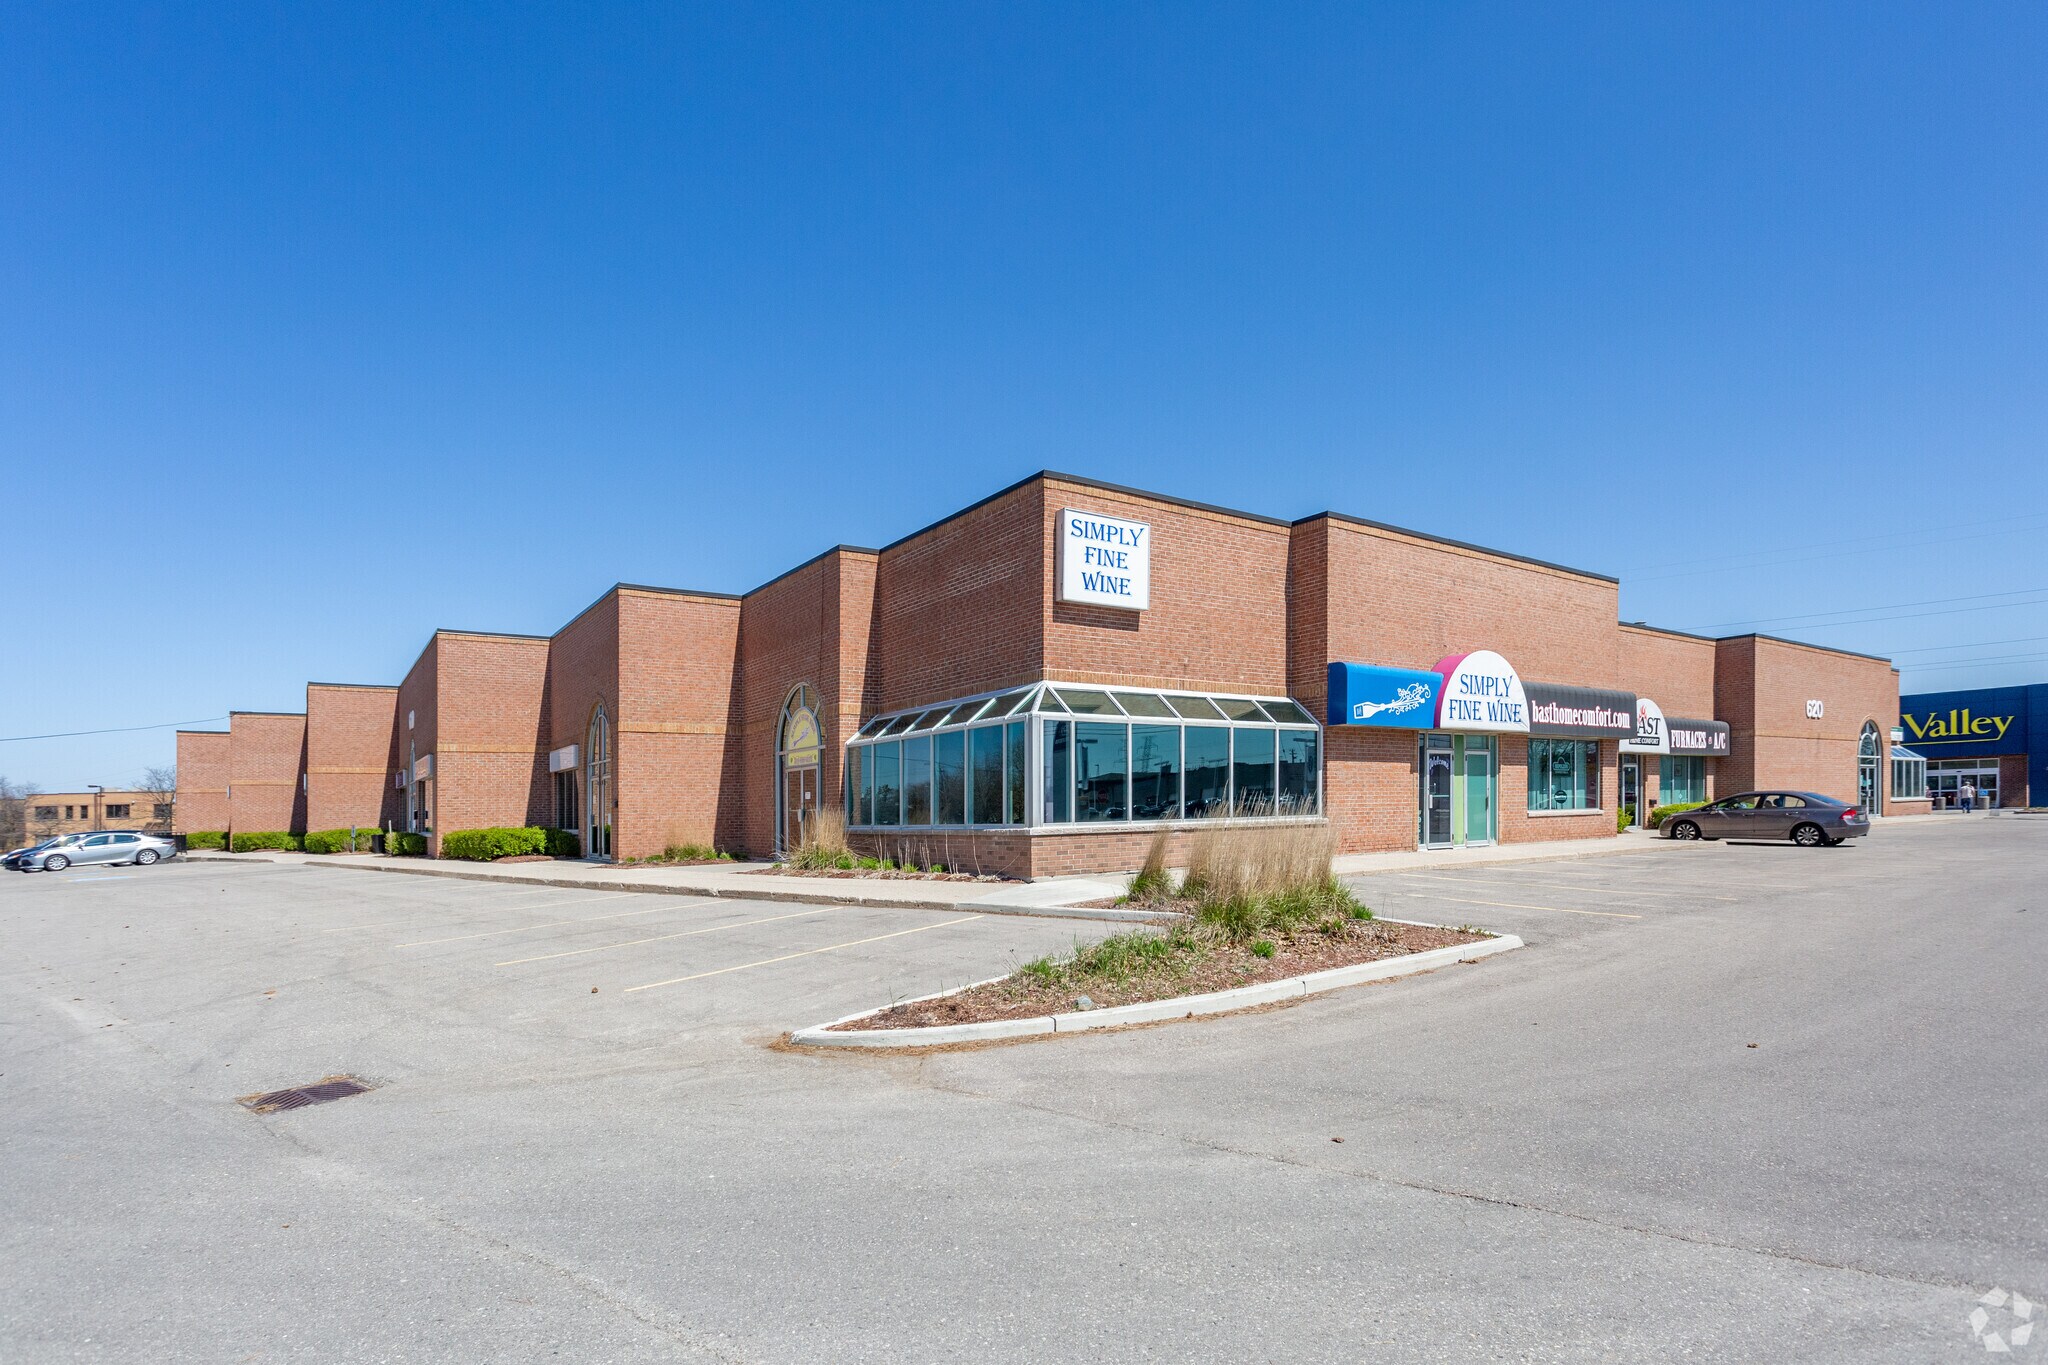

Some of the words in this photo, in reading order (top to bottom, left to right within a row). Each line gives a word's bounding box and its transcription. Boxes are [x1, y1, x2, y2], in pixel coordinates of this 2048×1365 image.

[1070, 518, 1145, 547] SIMPLY
[1084, 545, 1129, 570] FINE
[1081, 570, 1131, 596] WINE
[1460, 673, 1513, 698] SIMPLY
[1449, 699, 1482, 721] FINE
[1486, 698, 1522, 723] WINE
[1531, 700, 1631, 729] basthomecomfort.com
[1806, 700, 1823, 719] 620
[1636, 717, 1661, 735] AST
[1902, 709, 2014, 740] Valley
[1670, 729, 1707, 749] FURNACES
[1713, 732, 1726, 749] A/C
